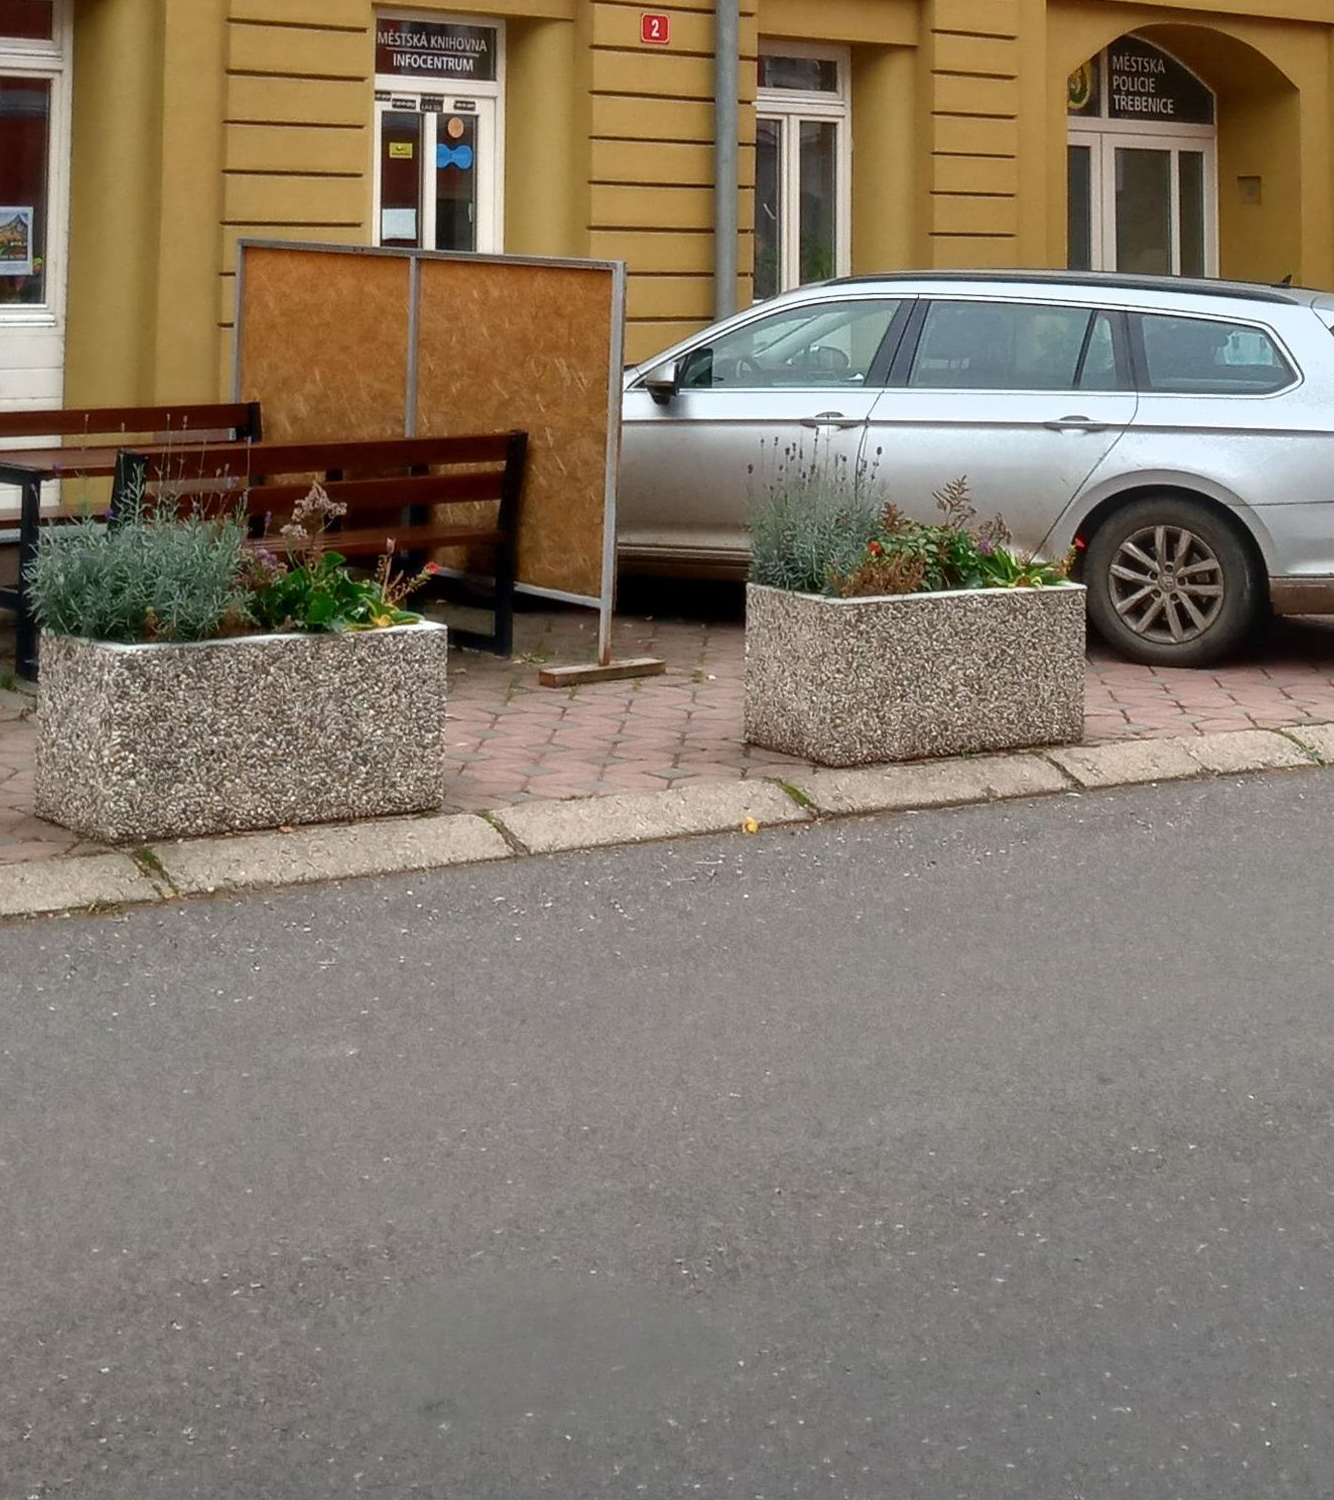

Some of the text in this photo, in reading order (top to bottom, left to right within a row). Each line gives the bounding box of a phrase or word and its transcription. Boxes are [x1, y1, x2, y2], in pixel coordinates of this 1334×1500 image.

[651, 19, 660, 37] 2
[378, 29, 487, 52] MĚSTSKÁ KNIHOVNA
[393, 53, 474, 73] INFOCENTRUM
[1113, 75, 1156, 93] POLICIE
[1113, 92, 1174, 114] TŘEBENICE
